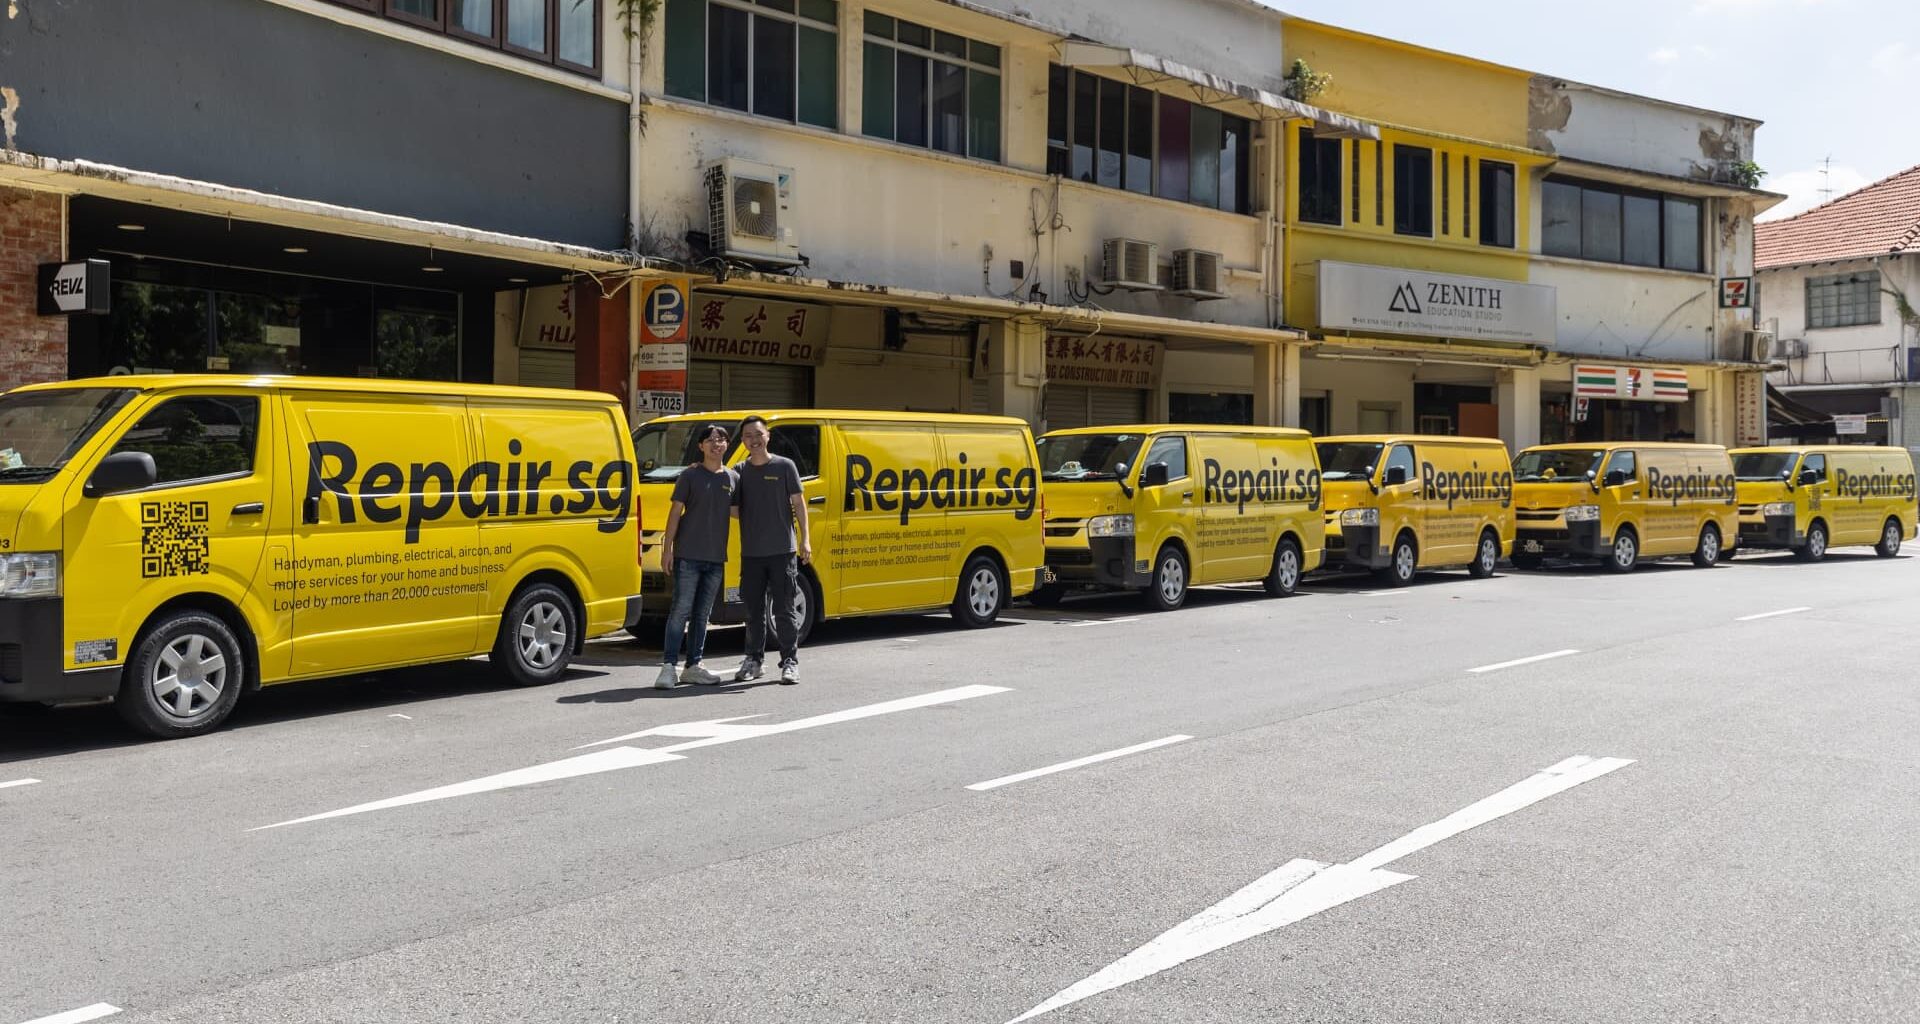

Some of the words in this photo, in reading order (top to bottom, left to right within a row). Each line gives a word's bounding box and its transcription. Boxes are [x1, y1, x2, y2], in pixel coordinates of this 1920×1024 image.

[1427, 282, 1502, 310] ZENITH
[1427, 306, 1472, 319] EDUCATION
[1475, 310, 1503, 321] STUDIO
[1059, 365, 1119, 383] CONSTRUCTION
[1120, 369, 1134, 384] PTE
[652, 397, 681, 410] T0025
[303, 438, 633, 544] Repair.sg
[843, 451, 1036, 526] Repair.sg
[1203, 456, 1321, 515] Repair.sg
[1422, 460, 1512, 511] Repair.sg
[1647, 466, 1736, 507] Repair.sg
[1836, 466, 1915, 504] Repair.sg
[274, 556, 343, 571] Handyman,
[346, 551, 402, 568] plumbing,
[404, 547, 456, 561] electrical,
[458, 545, 492, 558] aircon,
[494, 543, 512, 555] and
[851, 545, 877, 554] services
[878, 544, 888, 552] for
[889, 544, 903, 554] your
[904, 543, 922, 552] home
[274, 580, 306, 591] more
[309, 574, 359, 588] services
[362, 572, 377, 584] for
[380, 571, 405, 585] your
[407, 568, 437, 580] home
[439, 564, 458, 577] and
[831, 560, 851, 570] Loved
[852, 559, 860, 568] by
[862, 558, 878, 567] more
[880, 557, 894, 566] than
[273, 596, 311, 612] Loved
[314, 595, 328, 609] by
[331, 593, 361, 606] more
[364, 590, 389, 603] than
[391, 585, 430, 600] 20,000
[431, 580, 488, 597] customers!
